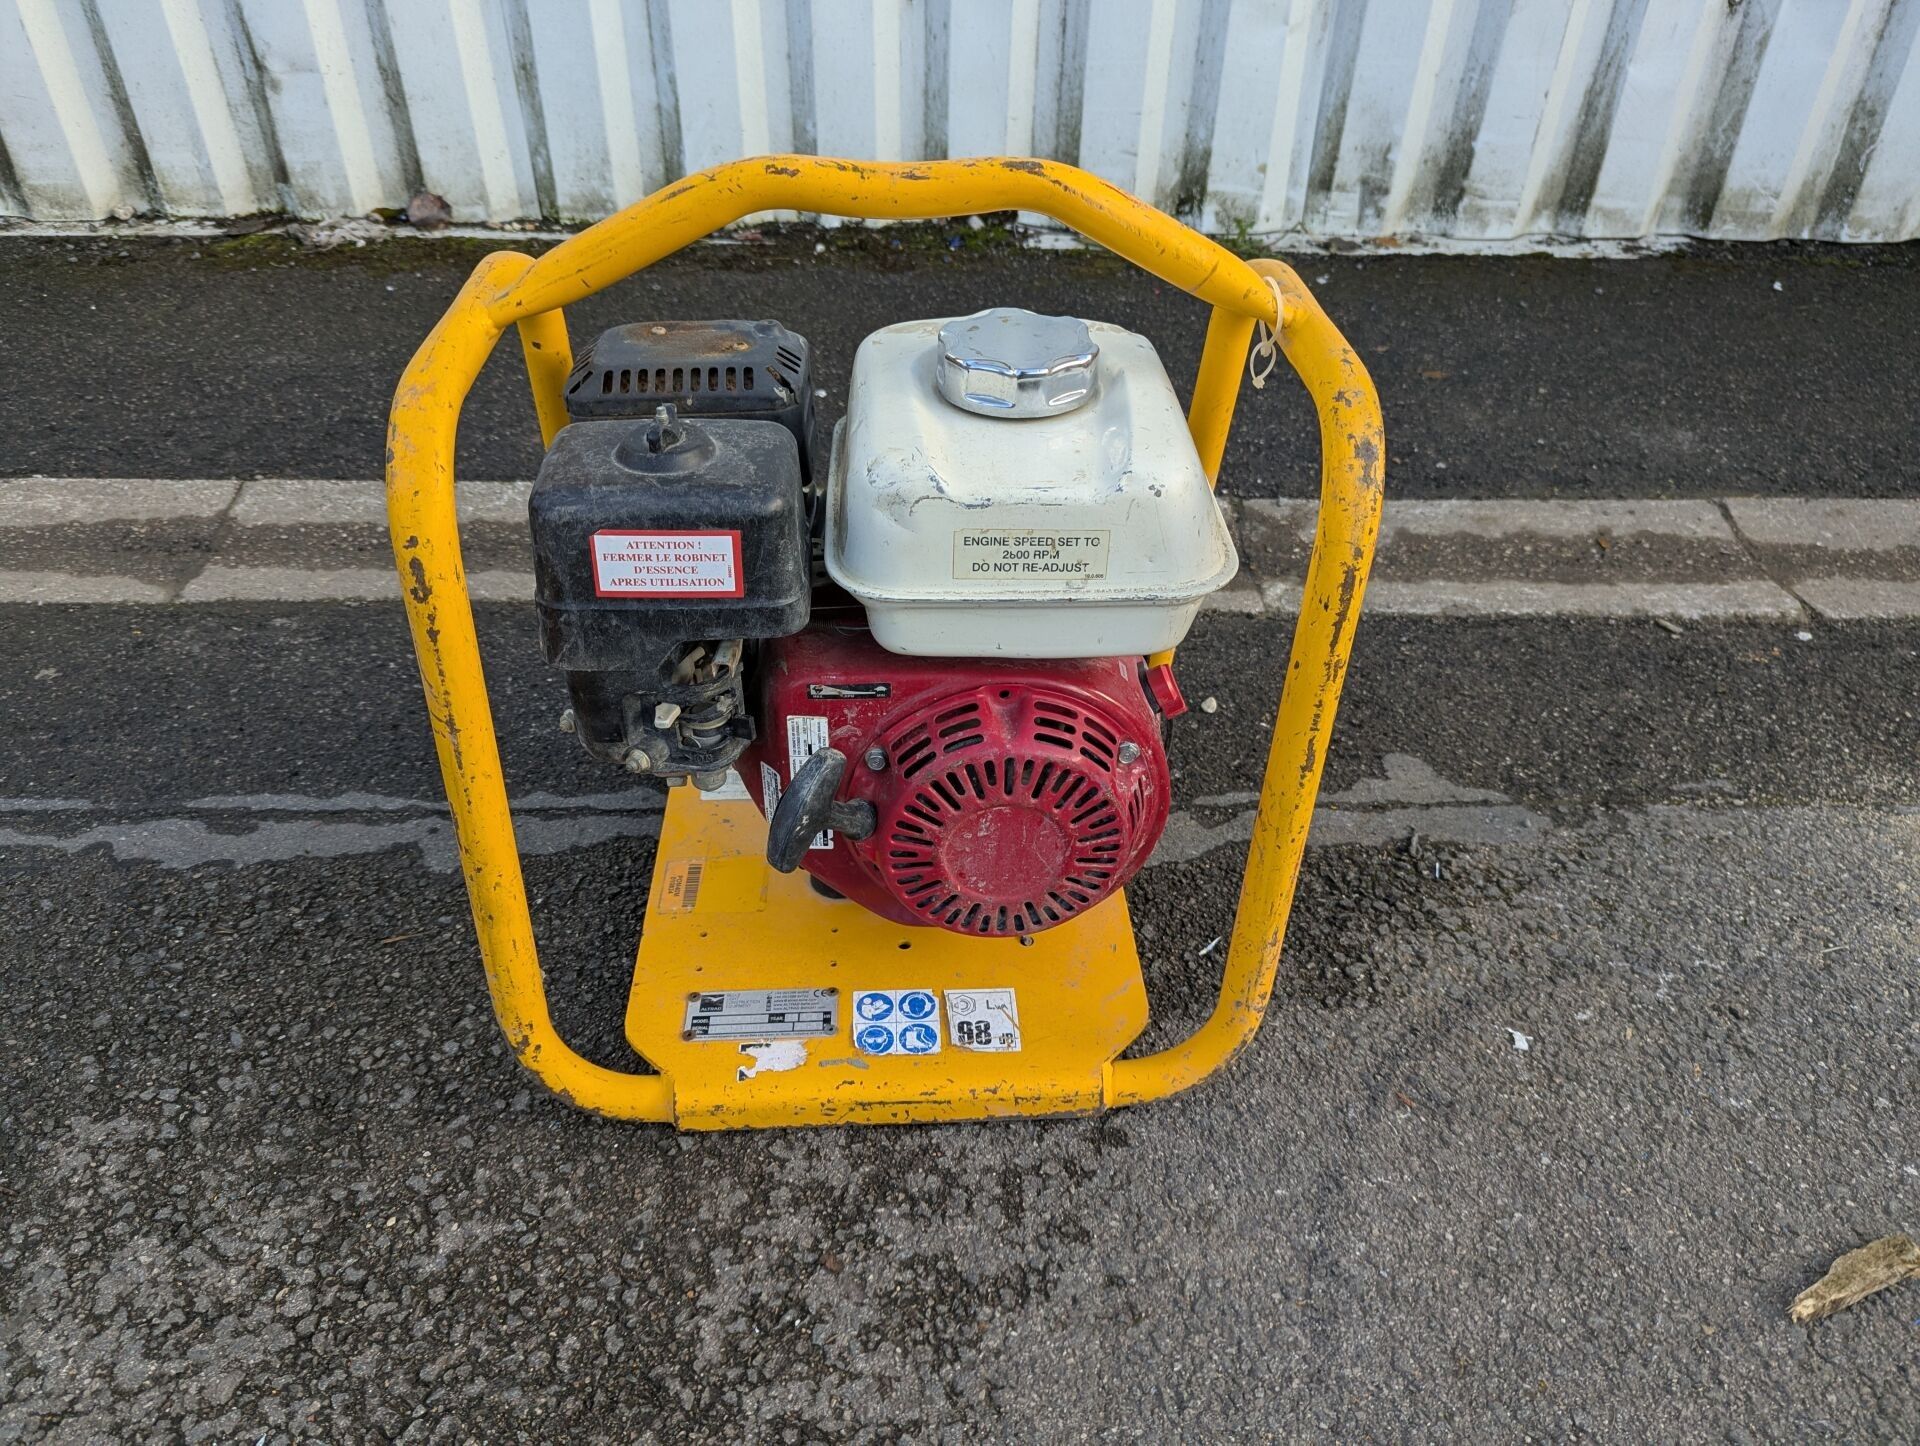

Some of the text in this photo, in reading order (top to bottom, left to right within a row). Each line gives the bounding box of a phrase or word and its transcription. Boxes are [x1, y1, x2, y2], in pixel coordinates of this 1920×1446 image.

[626, 541, 702, 550] ATTENTION !
[963, 536, 1100, 547] ENGINE SPEED SET TO
[602, 553, 727, 563] FERMER LE ROBINET
[1033, 550, 1060, 560] RPM
[634, 565, 698, 575] D'ESSENCE
[972, 562, 1090, 573] DO NOT RE-ADJUST
[610, 578, 725, 587] APRES UTILISATION
[957, 1020, 992, 1045] 98
